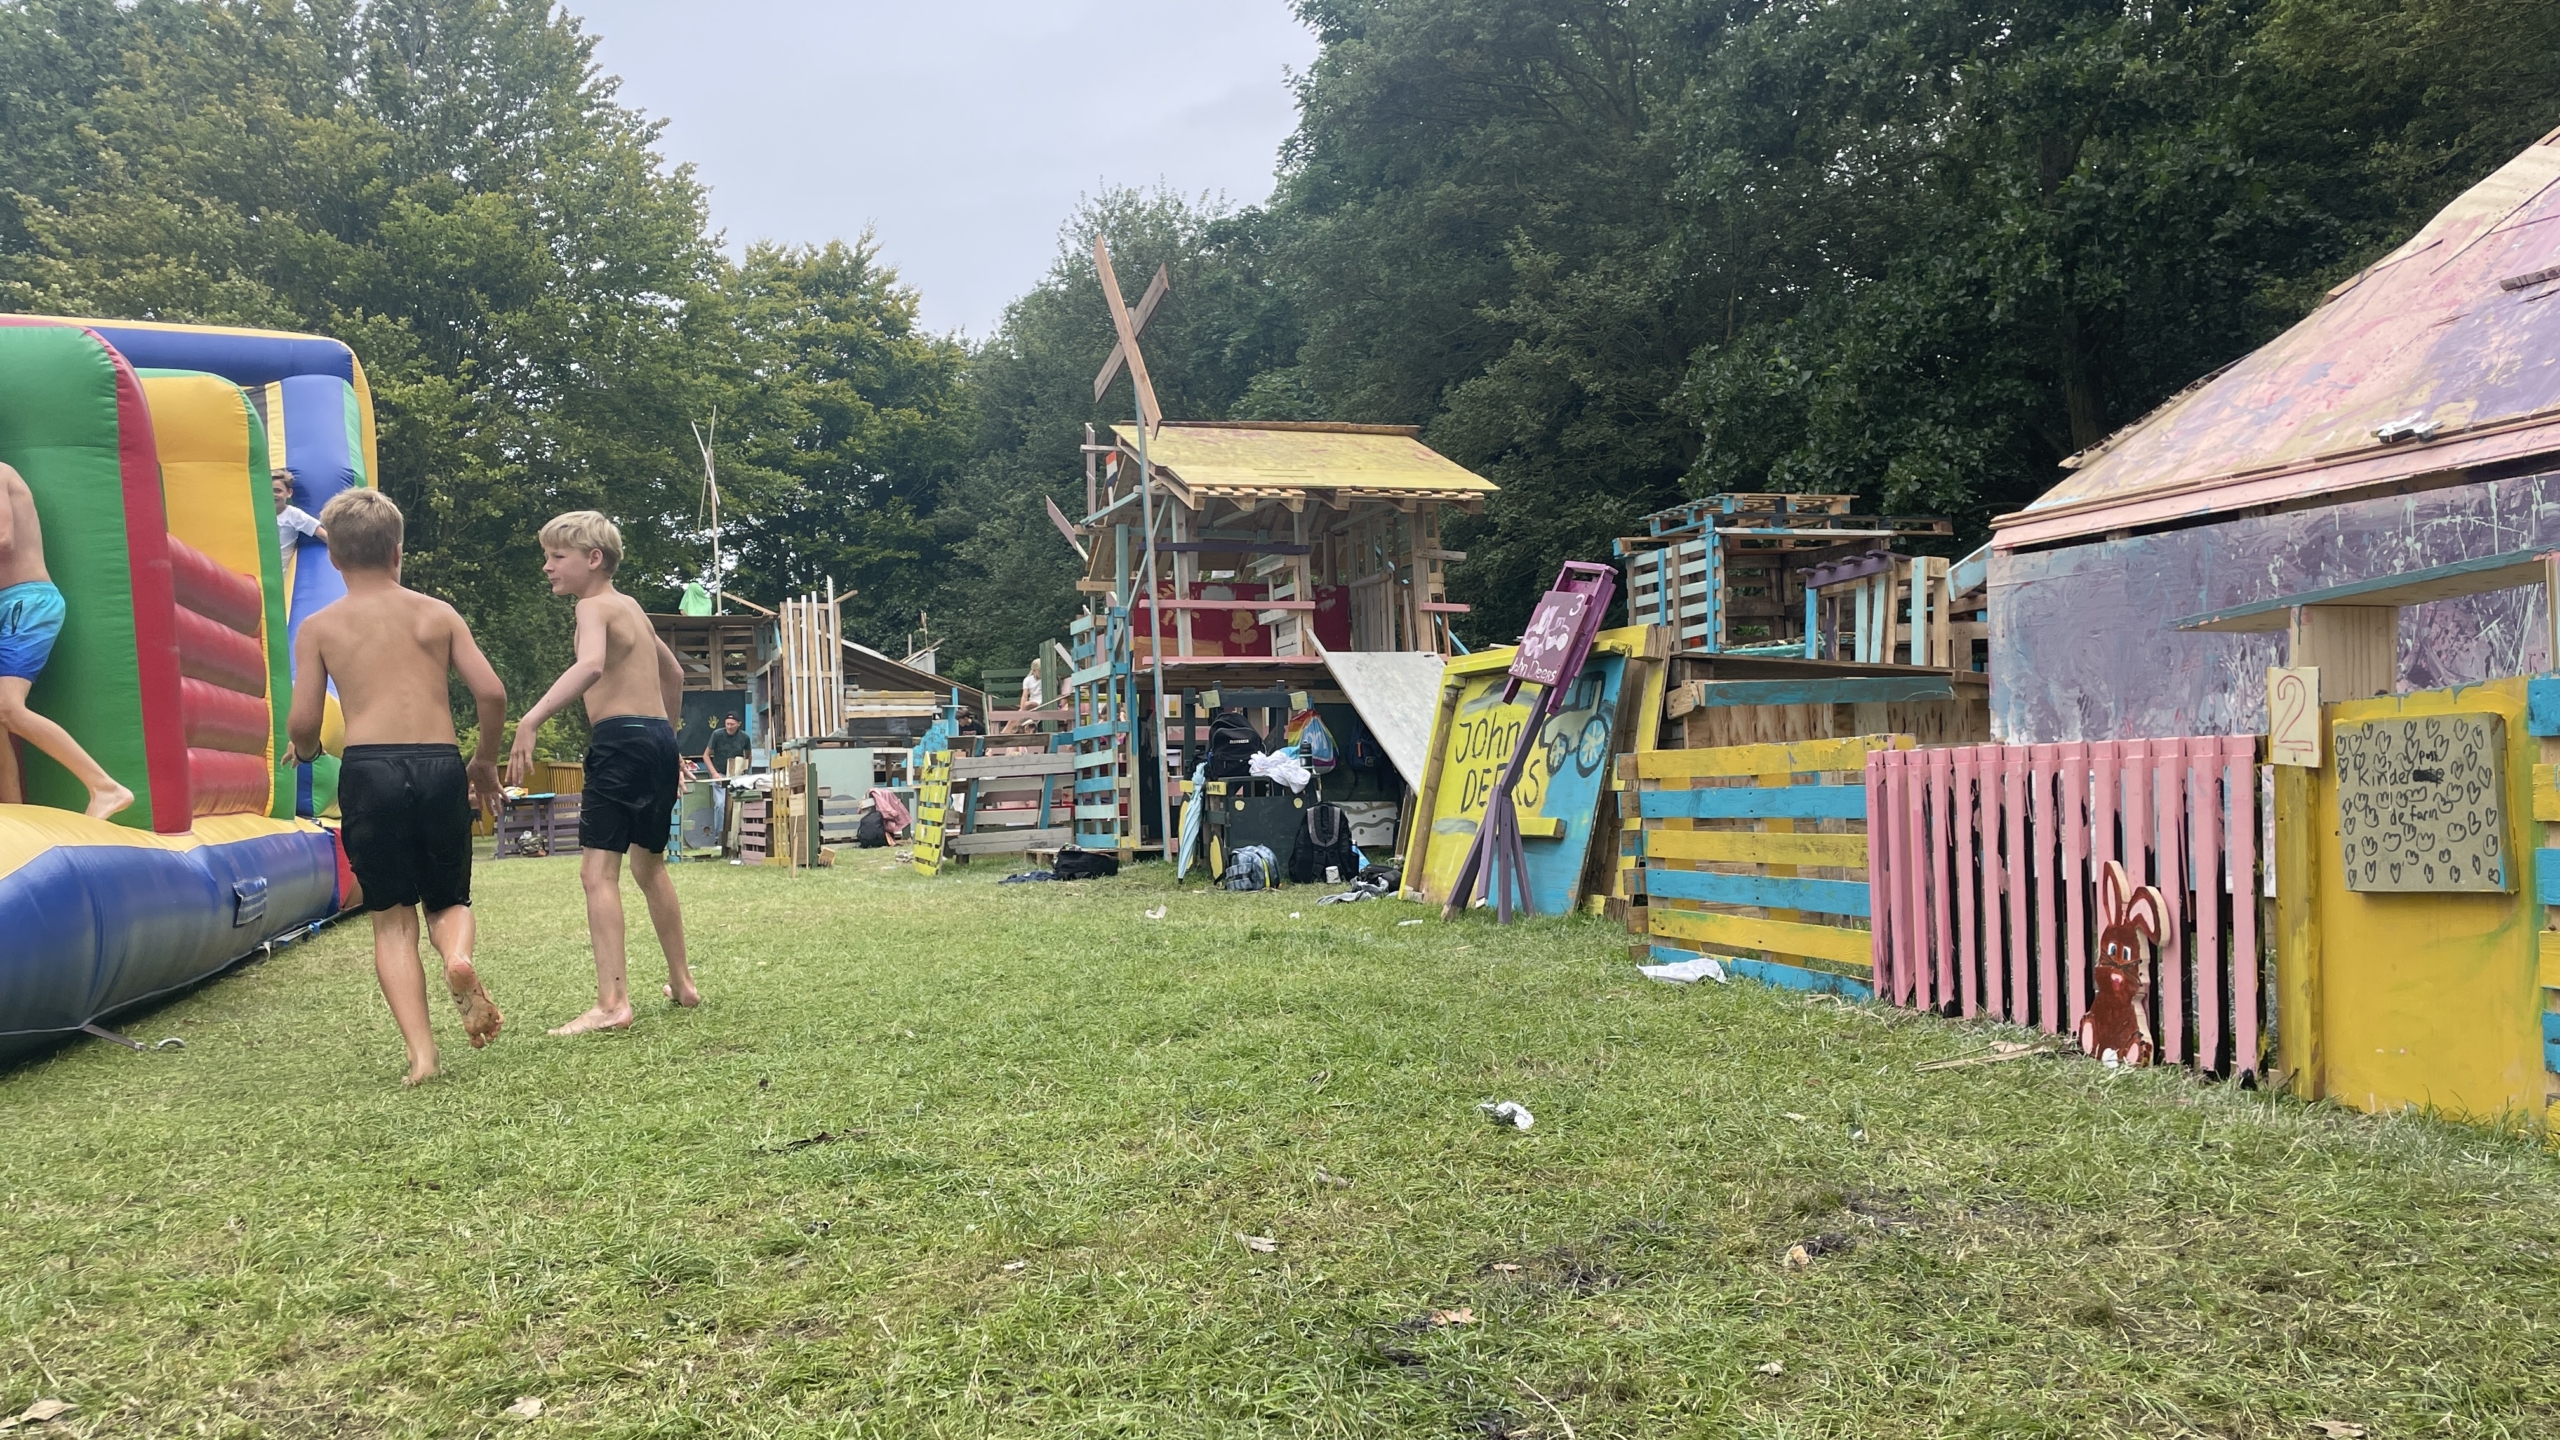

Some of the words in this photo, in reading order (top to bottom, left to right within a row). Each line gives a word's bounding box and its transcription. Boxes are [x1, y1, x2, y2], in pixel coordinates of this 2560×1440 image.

[1568, 593, 1586, 616] 3
[1508, 655, 1529, 678] John
[2273, 674, 2314, 753] 2
[2390, 808, 2406, 826] de
